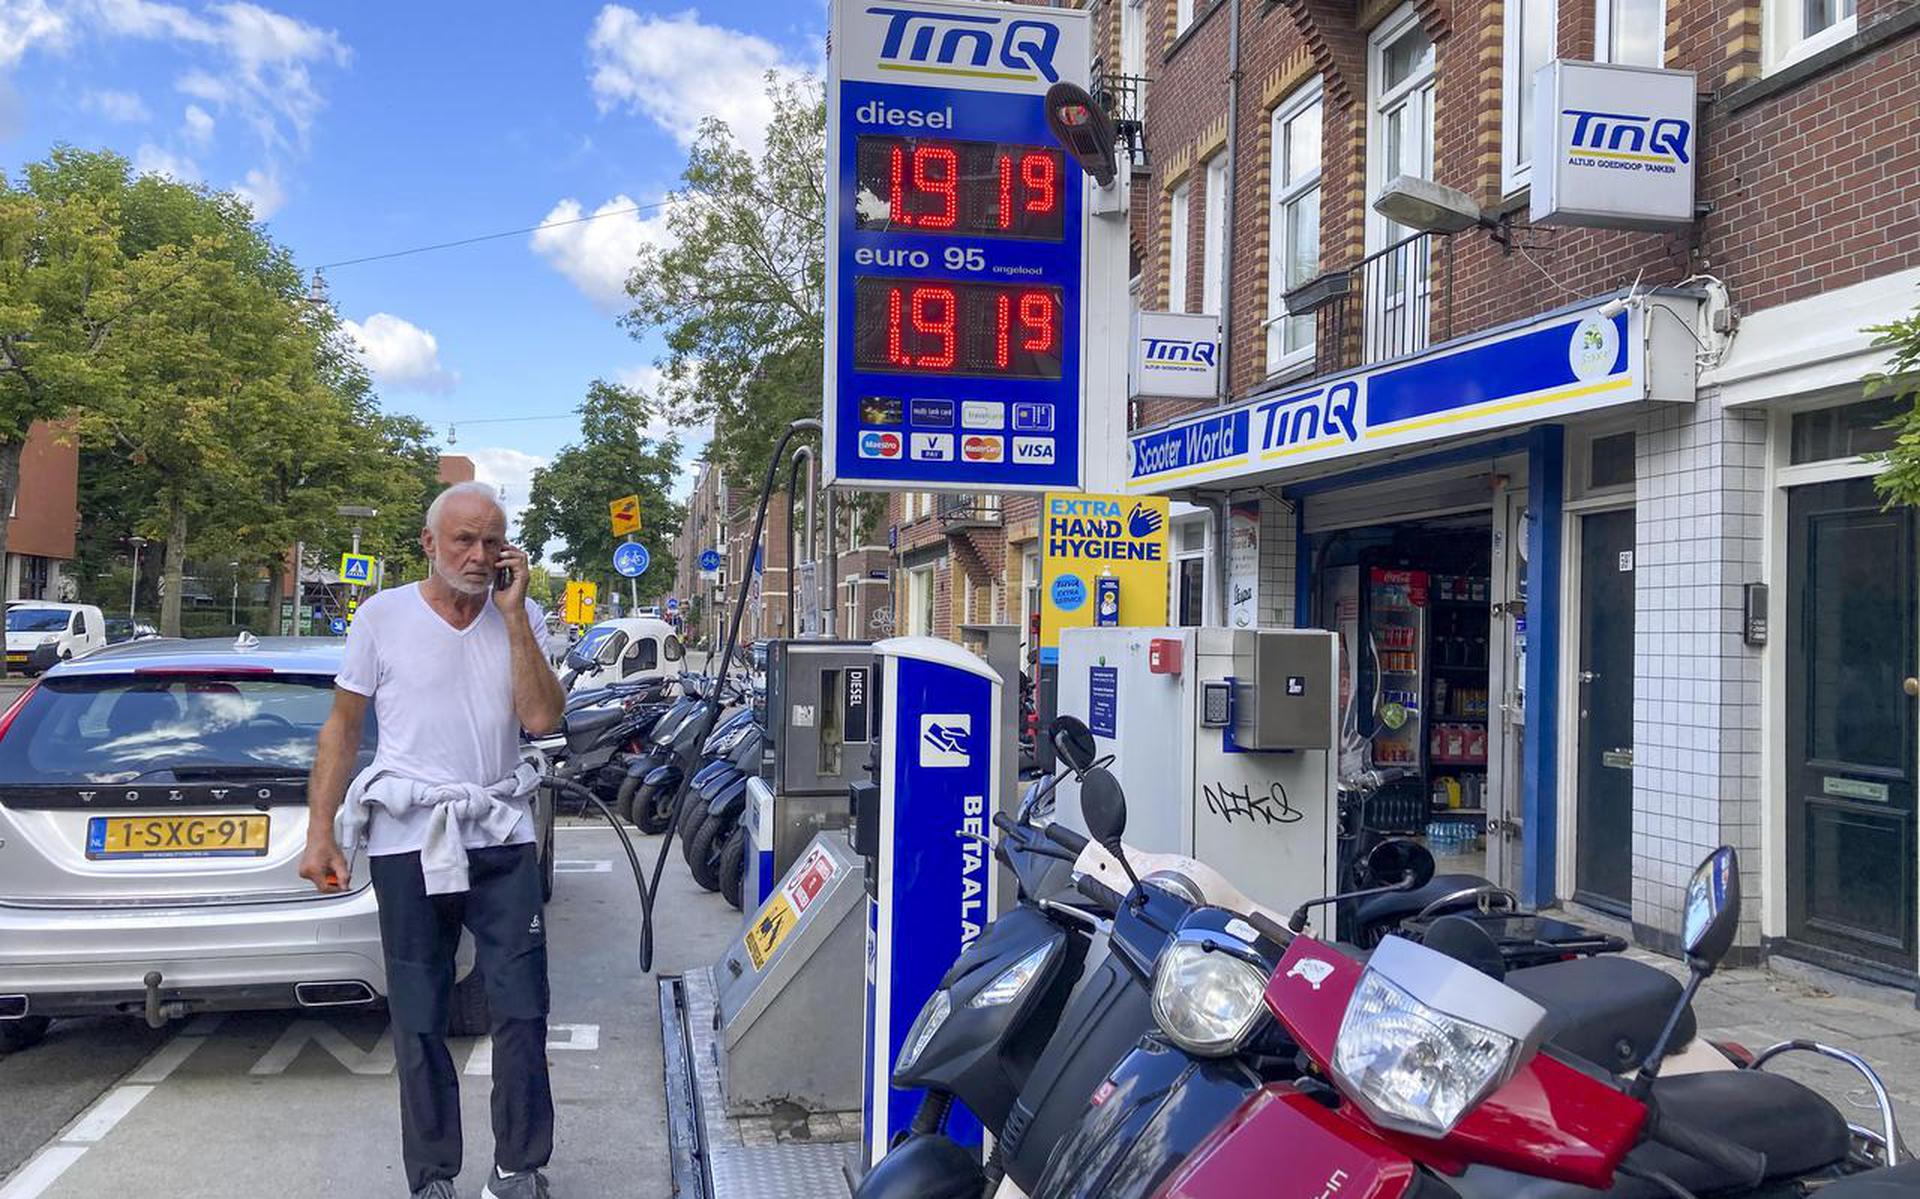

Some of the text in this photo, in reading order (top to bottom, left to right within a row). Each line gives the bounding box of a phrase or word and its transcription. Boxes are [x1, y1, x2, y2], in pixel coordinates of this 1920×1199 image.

[856, 101, 953, 129] diesel
[1568, 157, 1676, 174] ALTIJD GOEDKOOP TANKEN
[855, 247, 1043, 276] euro 95 ongelood
[865, 440, 897, 450] Maestro
[927, 437, 938, 449] V
[1018, 444, 1053, 458] VISA
[1138, 414, 1235, 475] Scooter World
[1051, 500, 1121, 517] EXTRA
[1051, 518, 1122, 538] HAND
[1050, 539, 1161, 560] HYGIENE
[850, 671, 862, 706] DIESEL
[77, 788, 271, 802] VOLVO
[122, 820, 249, 848] 1-SXG-91
[961, 795, 983, 953] BETAALA
